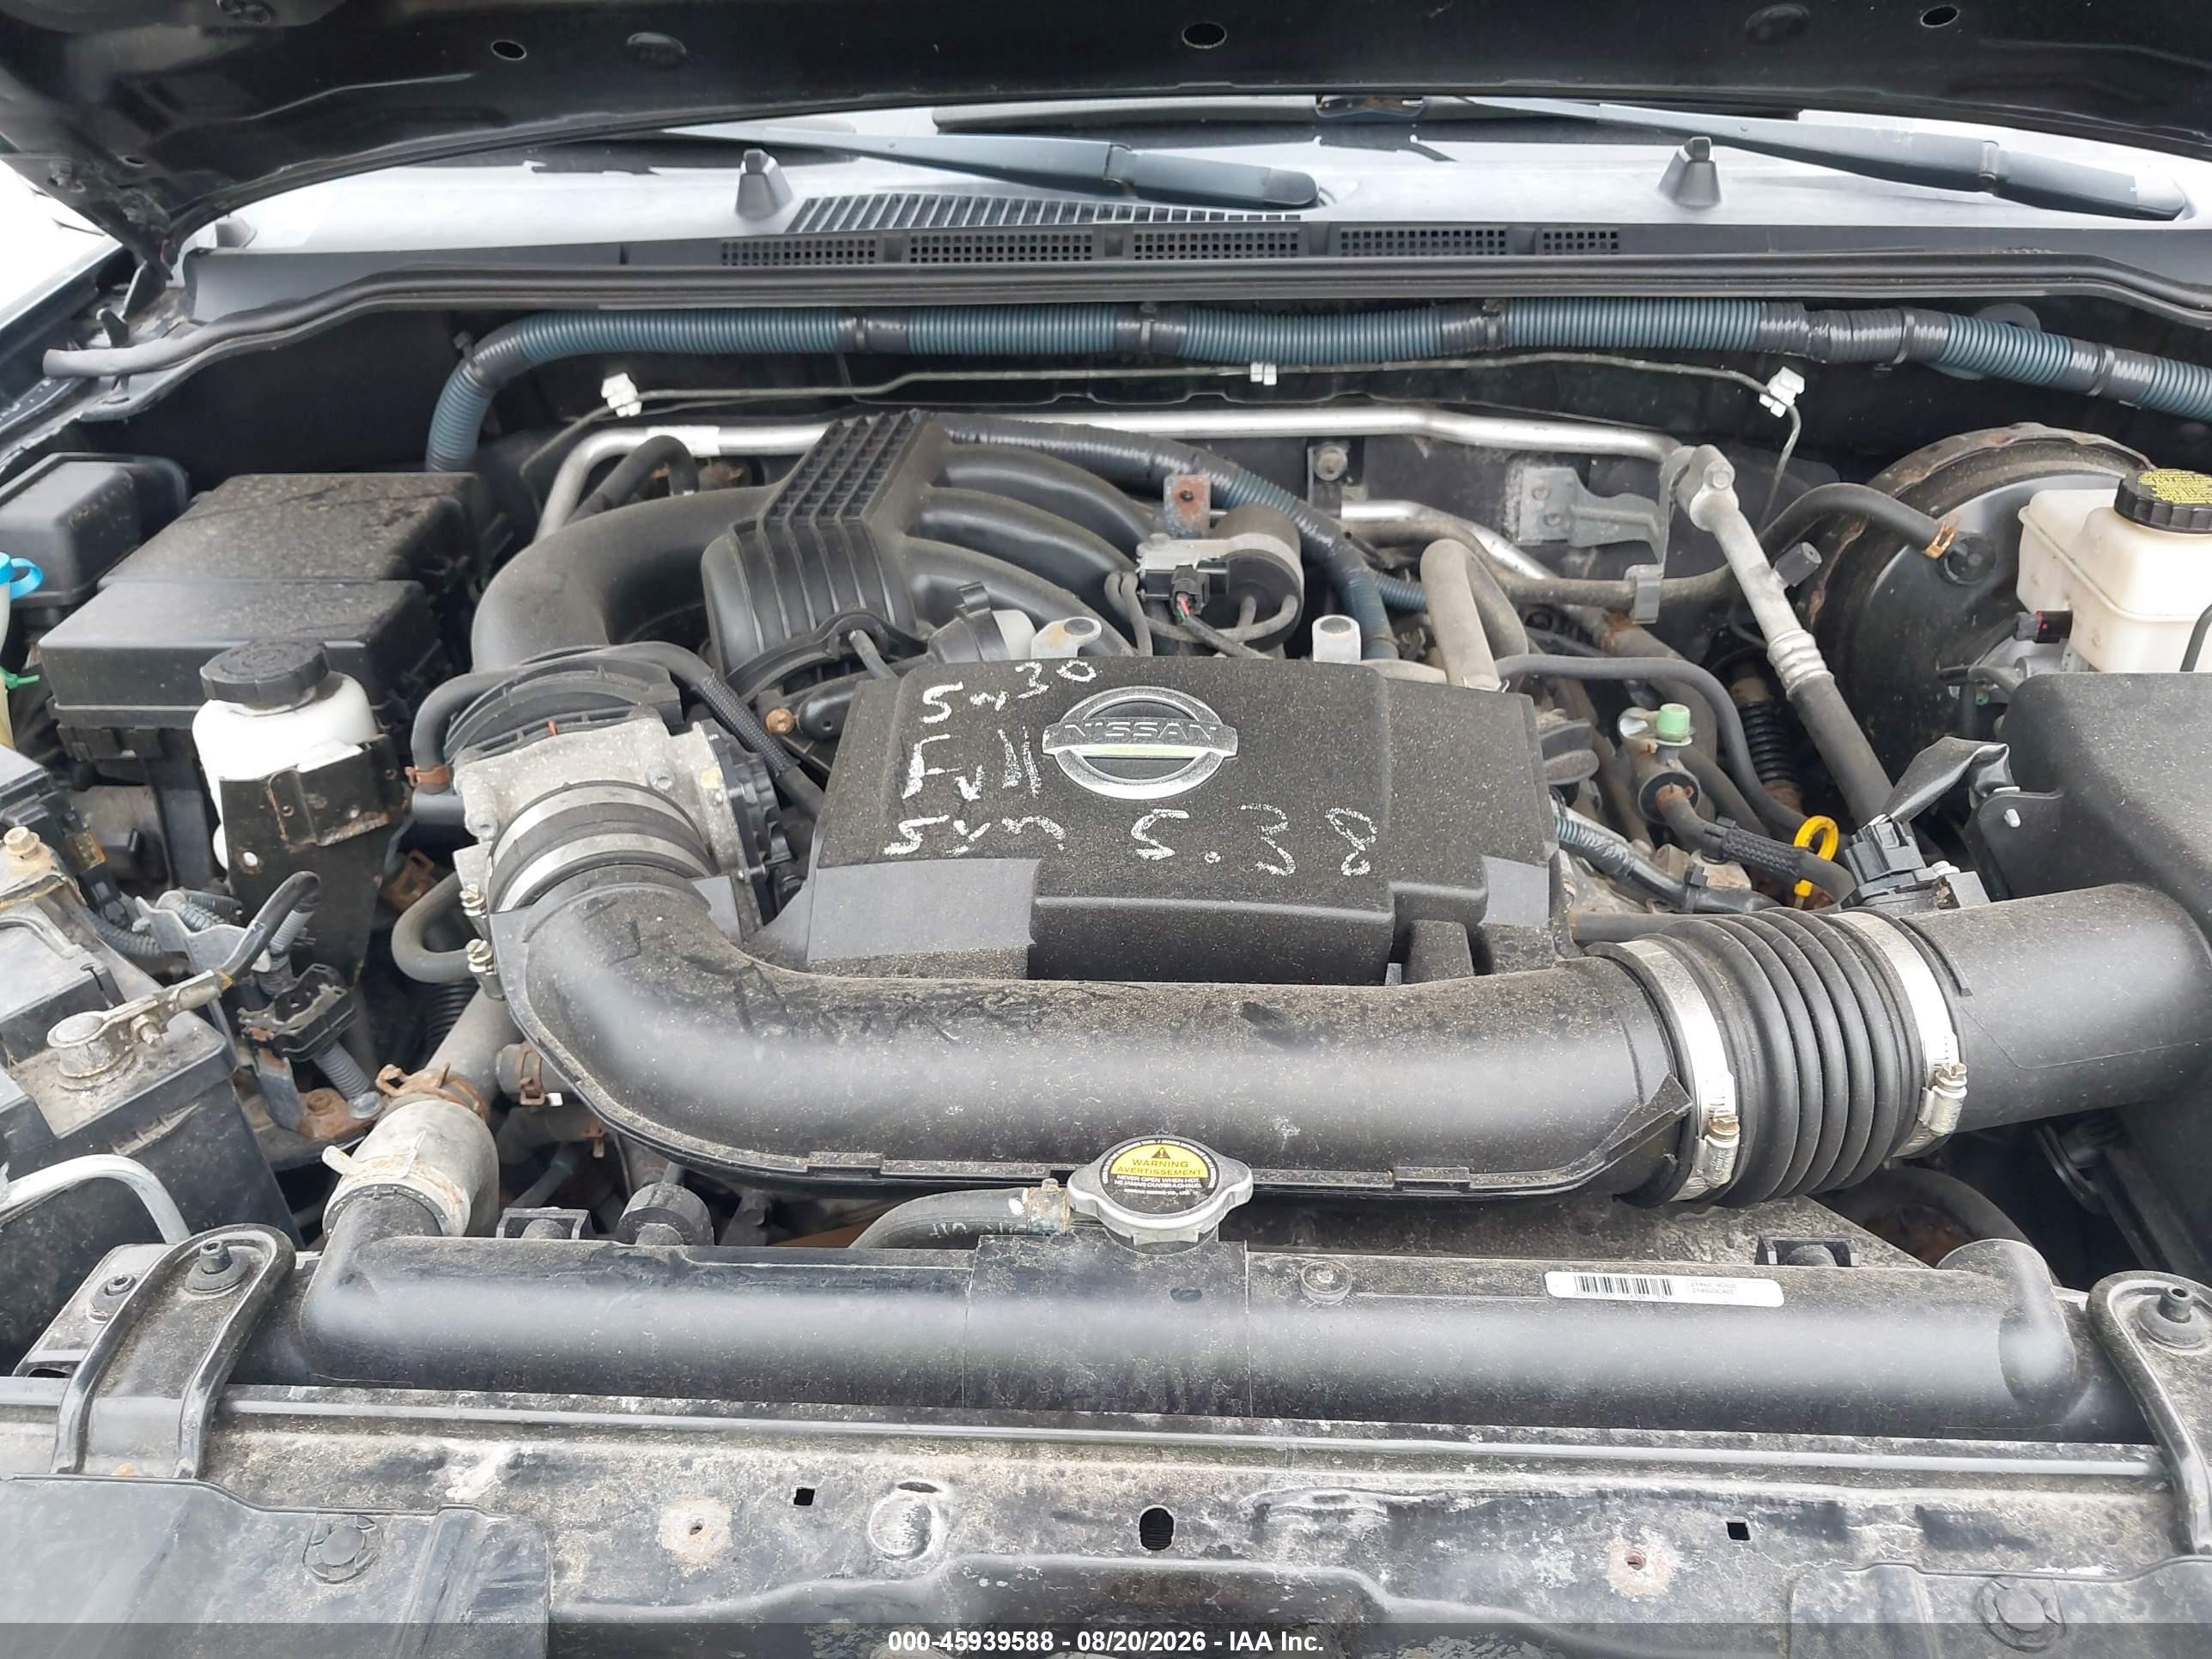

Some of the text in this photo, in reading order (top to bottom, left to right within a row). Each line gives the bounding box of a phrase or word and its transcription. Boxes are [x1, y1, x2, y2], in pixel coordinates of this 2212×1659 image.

[1064, 720, 1218, 741] NISSAN
[1132, 1159, 1189, 1168] WARNING
[1117, 1166, 1202, 1176] AVERTISSEMENT
